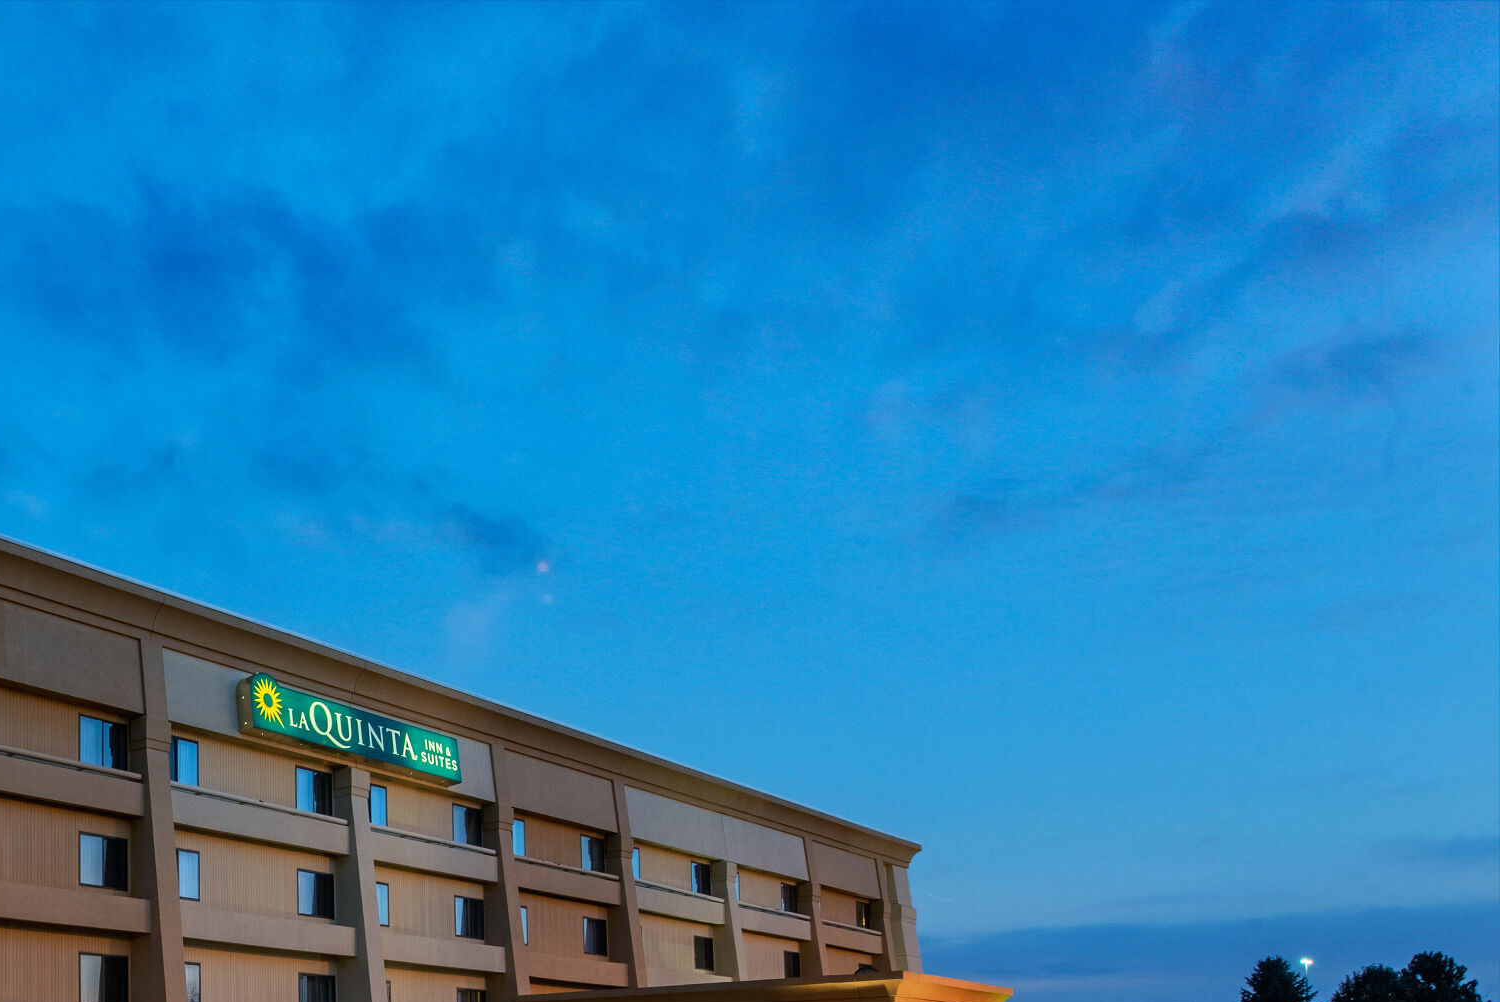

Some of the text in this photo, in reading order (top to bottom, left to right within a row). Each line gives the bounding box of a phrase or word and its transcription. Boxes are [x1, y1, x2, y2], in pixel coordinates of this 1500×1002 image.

[424, 738, 452, 757] INN &
[421, 751, 458, 771] SUITES
